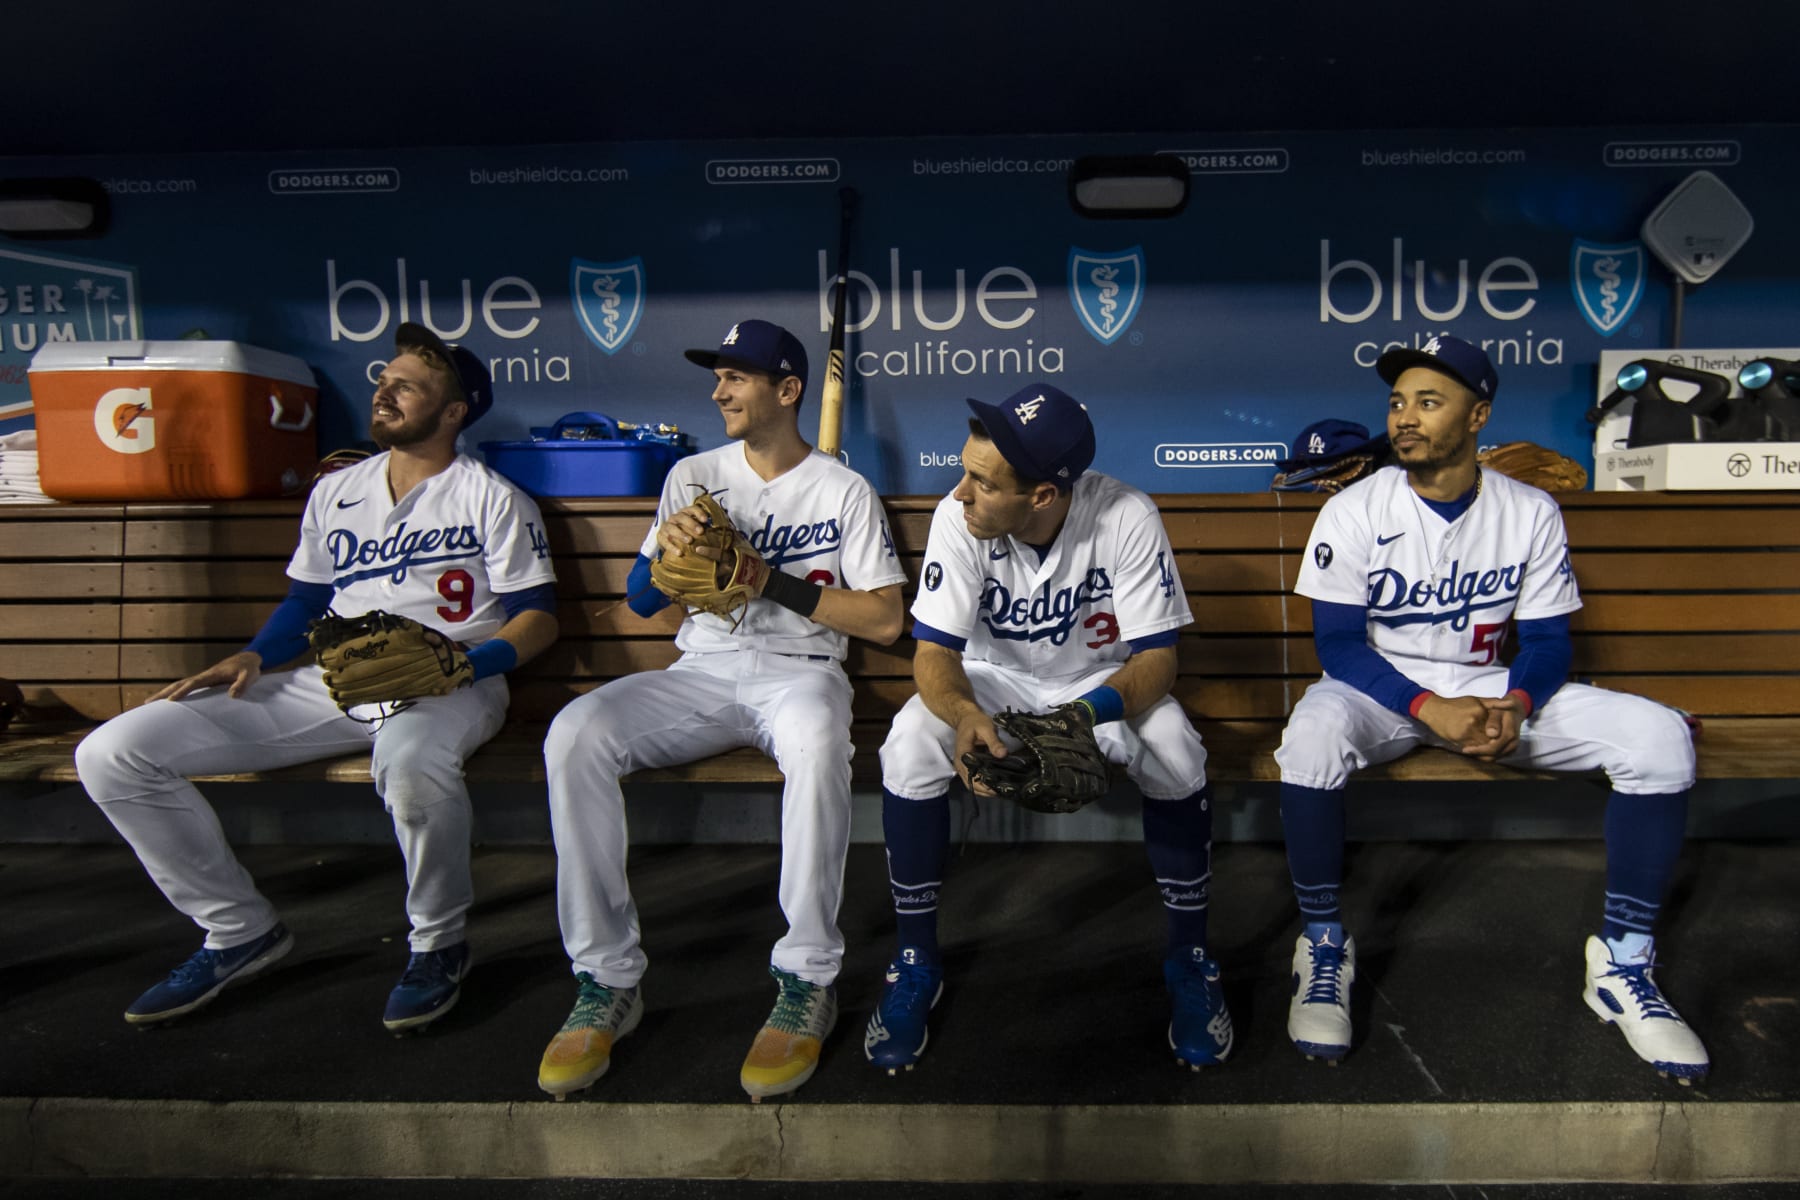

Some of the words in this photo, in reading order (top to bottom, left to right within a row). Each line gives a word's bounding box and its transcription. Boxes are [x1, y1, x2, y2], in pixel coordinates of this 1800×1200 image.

[1180, 154, 1278, 168] DGERS.COM
[1362, 147, 1525, 167] blueshieldca.com
[1613, 145, 1731, 161] DODGERS.COM
[469, 166, 629, 185] blueshieldca.com
[716, 162, 830, 178] DODGERS.COM
[100, 176, 197, 193] eldca.com
[278, 173, 390, 188] DODGERS.COM
[818, 247, 1038, 333] blue
[1320, 237, 1539, 324] blue
[326, 257, 542, 342] blue
[855, 338, 1065, 379] california
[1164, 446, 1278, 462] DODGERS.COM
[327, 520, 485, 591] Dodgers
[436, 568, 475, 623] 9
[1083, 611, 1121, 650] 3
